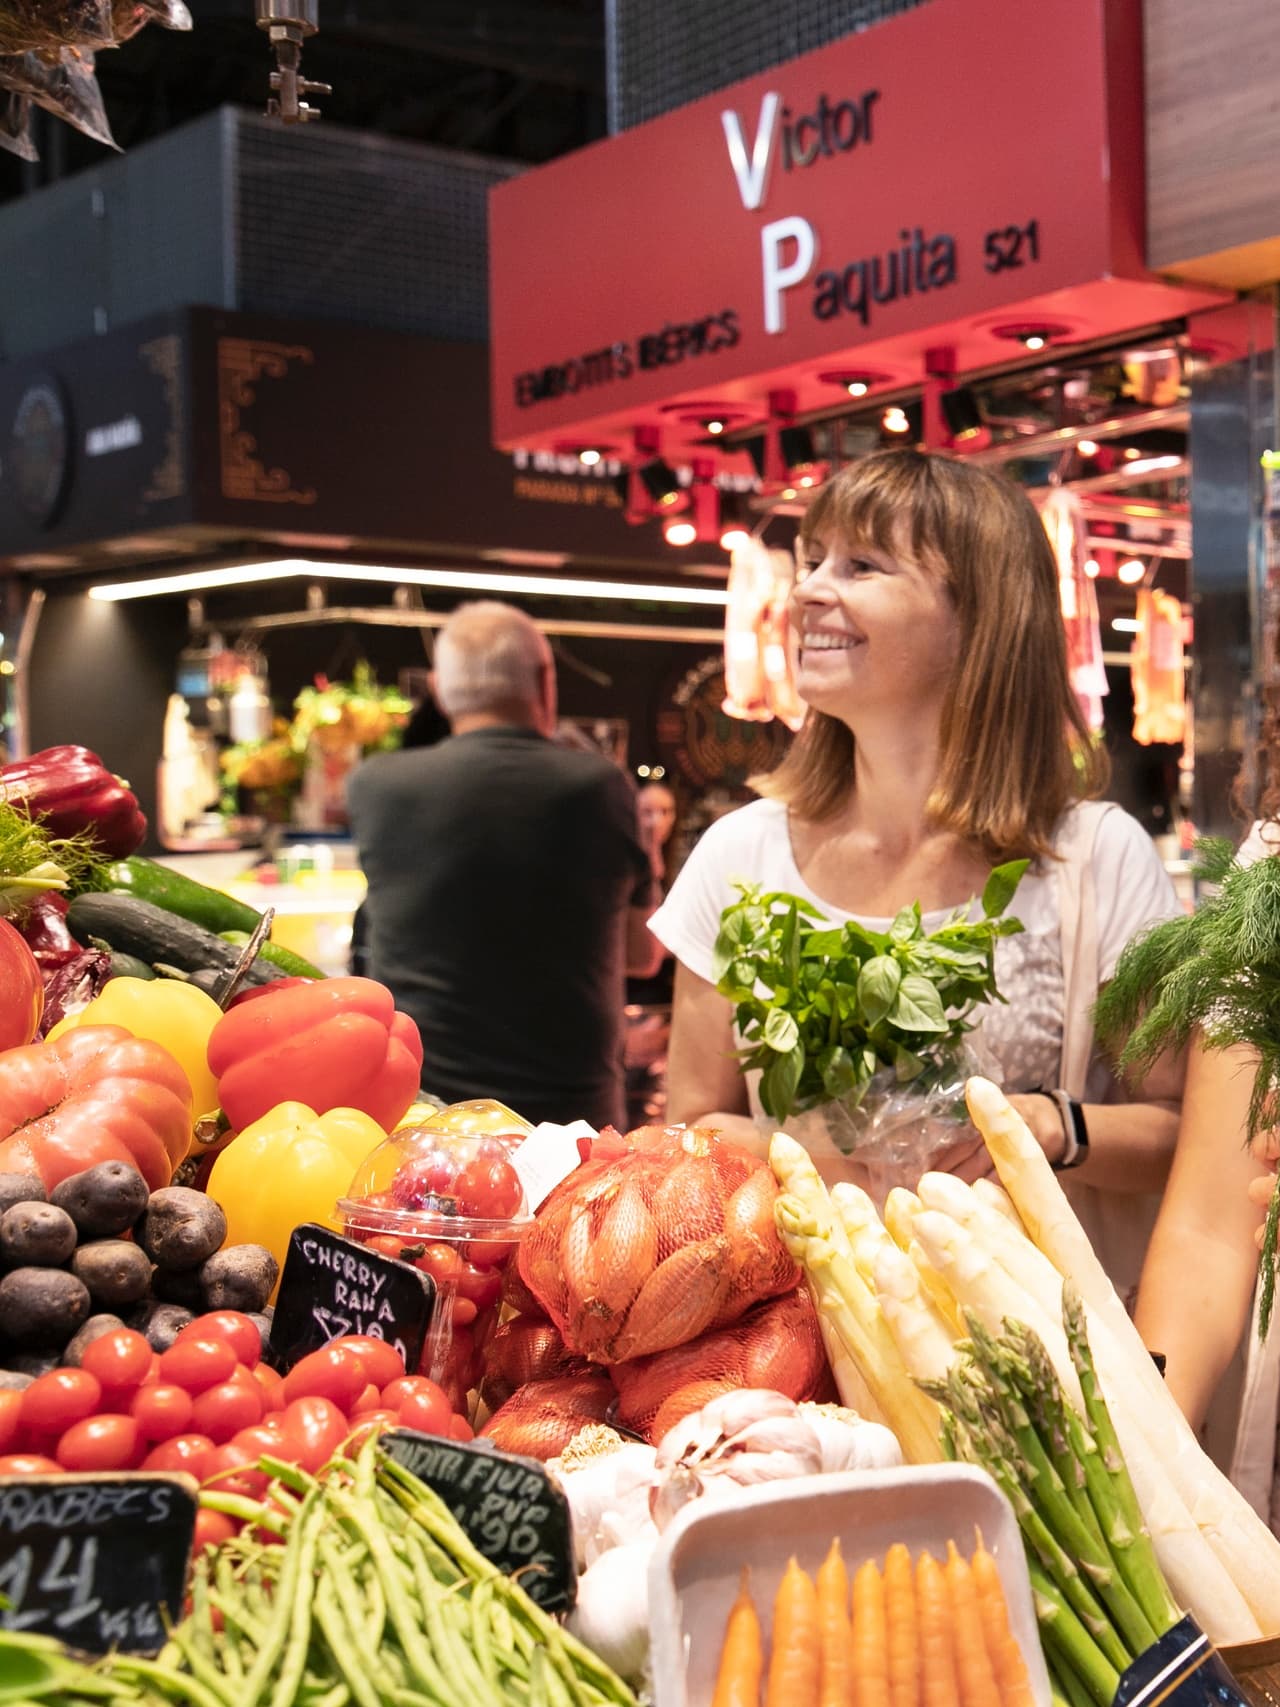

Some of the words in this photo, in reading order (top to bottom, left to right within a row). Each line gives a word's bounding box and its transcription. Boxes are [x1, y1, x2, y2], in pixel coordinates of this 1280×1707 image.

[721, 89, 879, 211] Victor
[761, 215, 957, 334] Paquita
[984, 219, 1041, 274] 521
[303, 1239, 387, 1295] CHERRY
